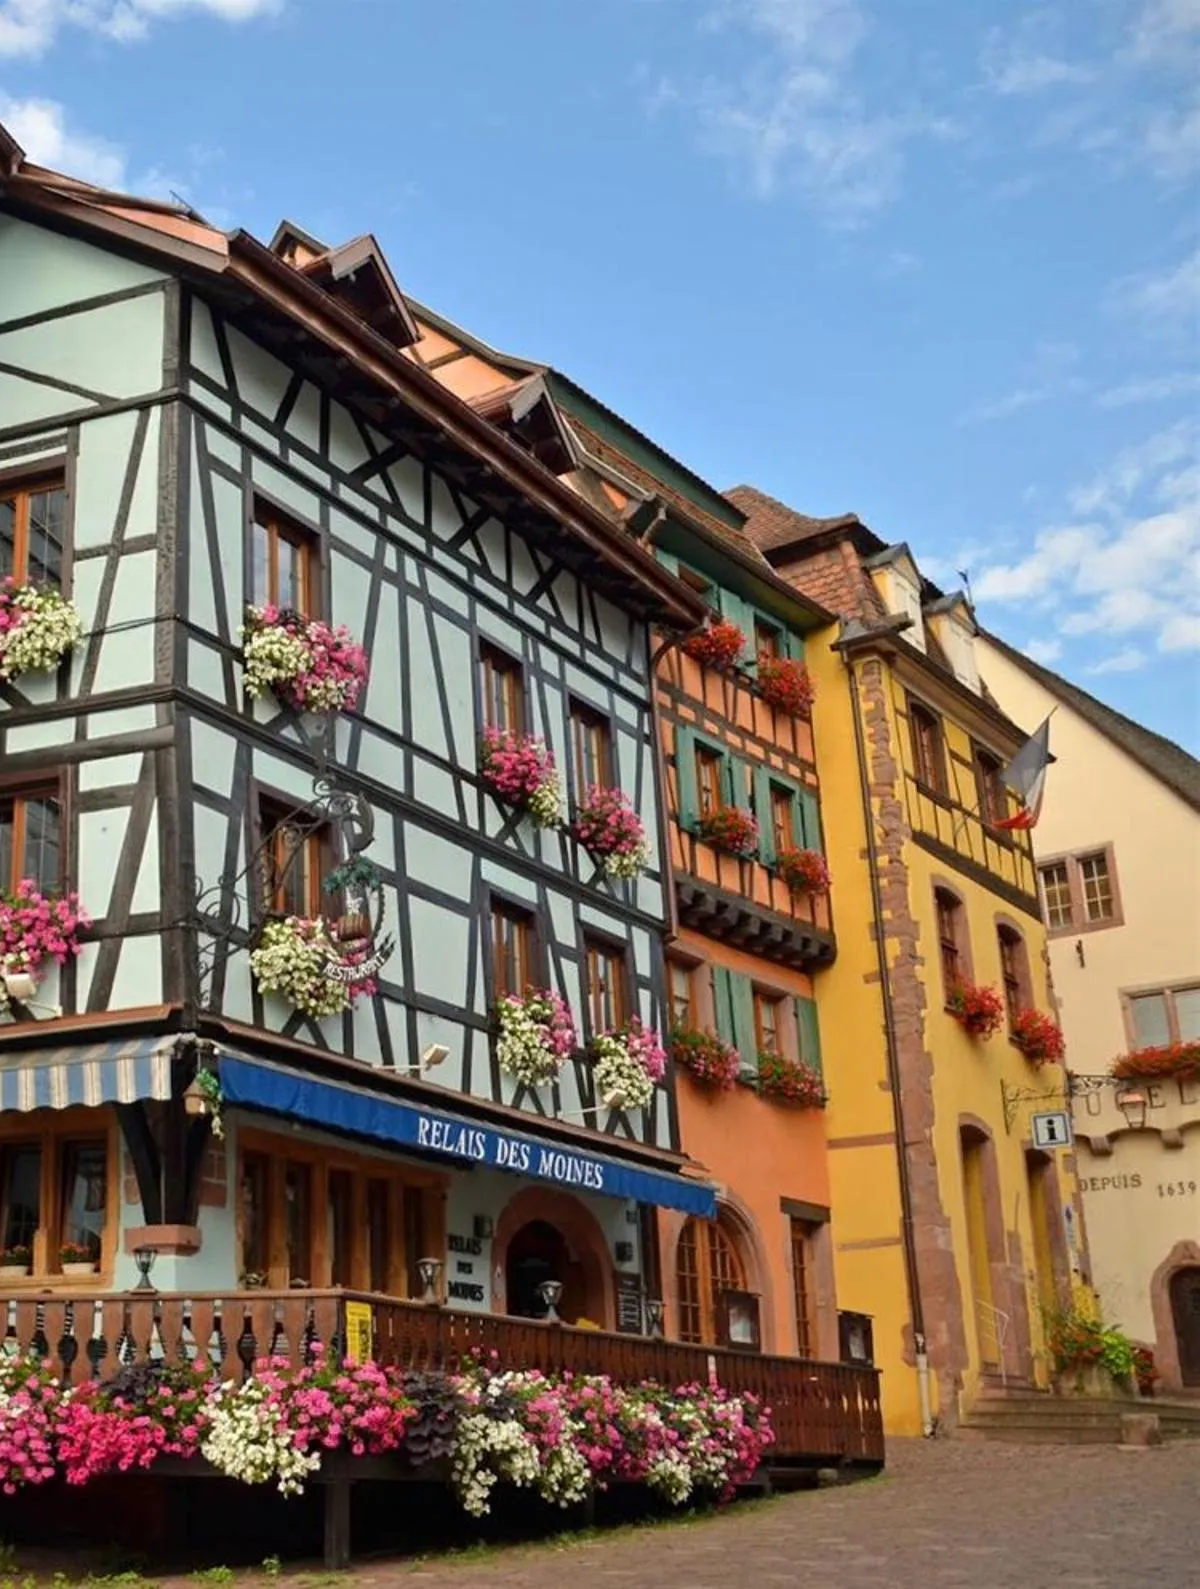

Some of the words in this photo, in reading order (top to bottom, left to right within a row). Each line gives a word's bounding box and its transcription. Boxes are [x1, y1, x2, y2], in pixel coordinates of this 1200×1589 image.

[322, 951, 386, 982] RESTAURANT
[418, 1116, 486, 1160] RELAIS
[496, 1137, 530, 1171] DES
[538, 1149, 604, 1189] MOINES
[1080, 1173, 1142, 1192] DEPUIS
[1157, 1180, 1197, 1198] 1639
